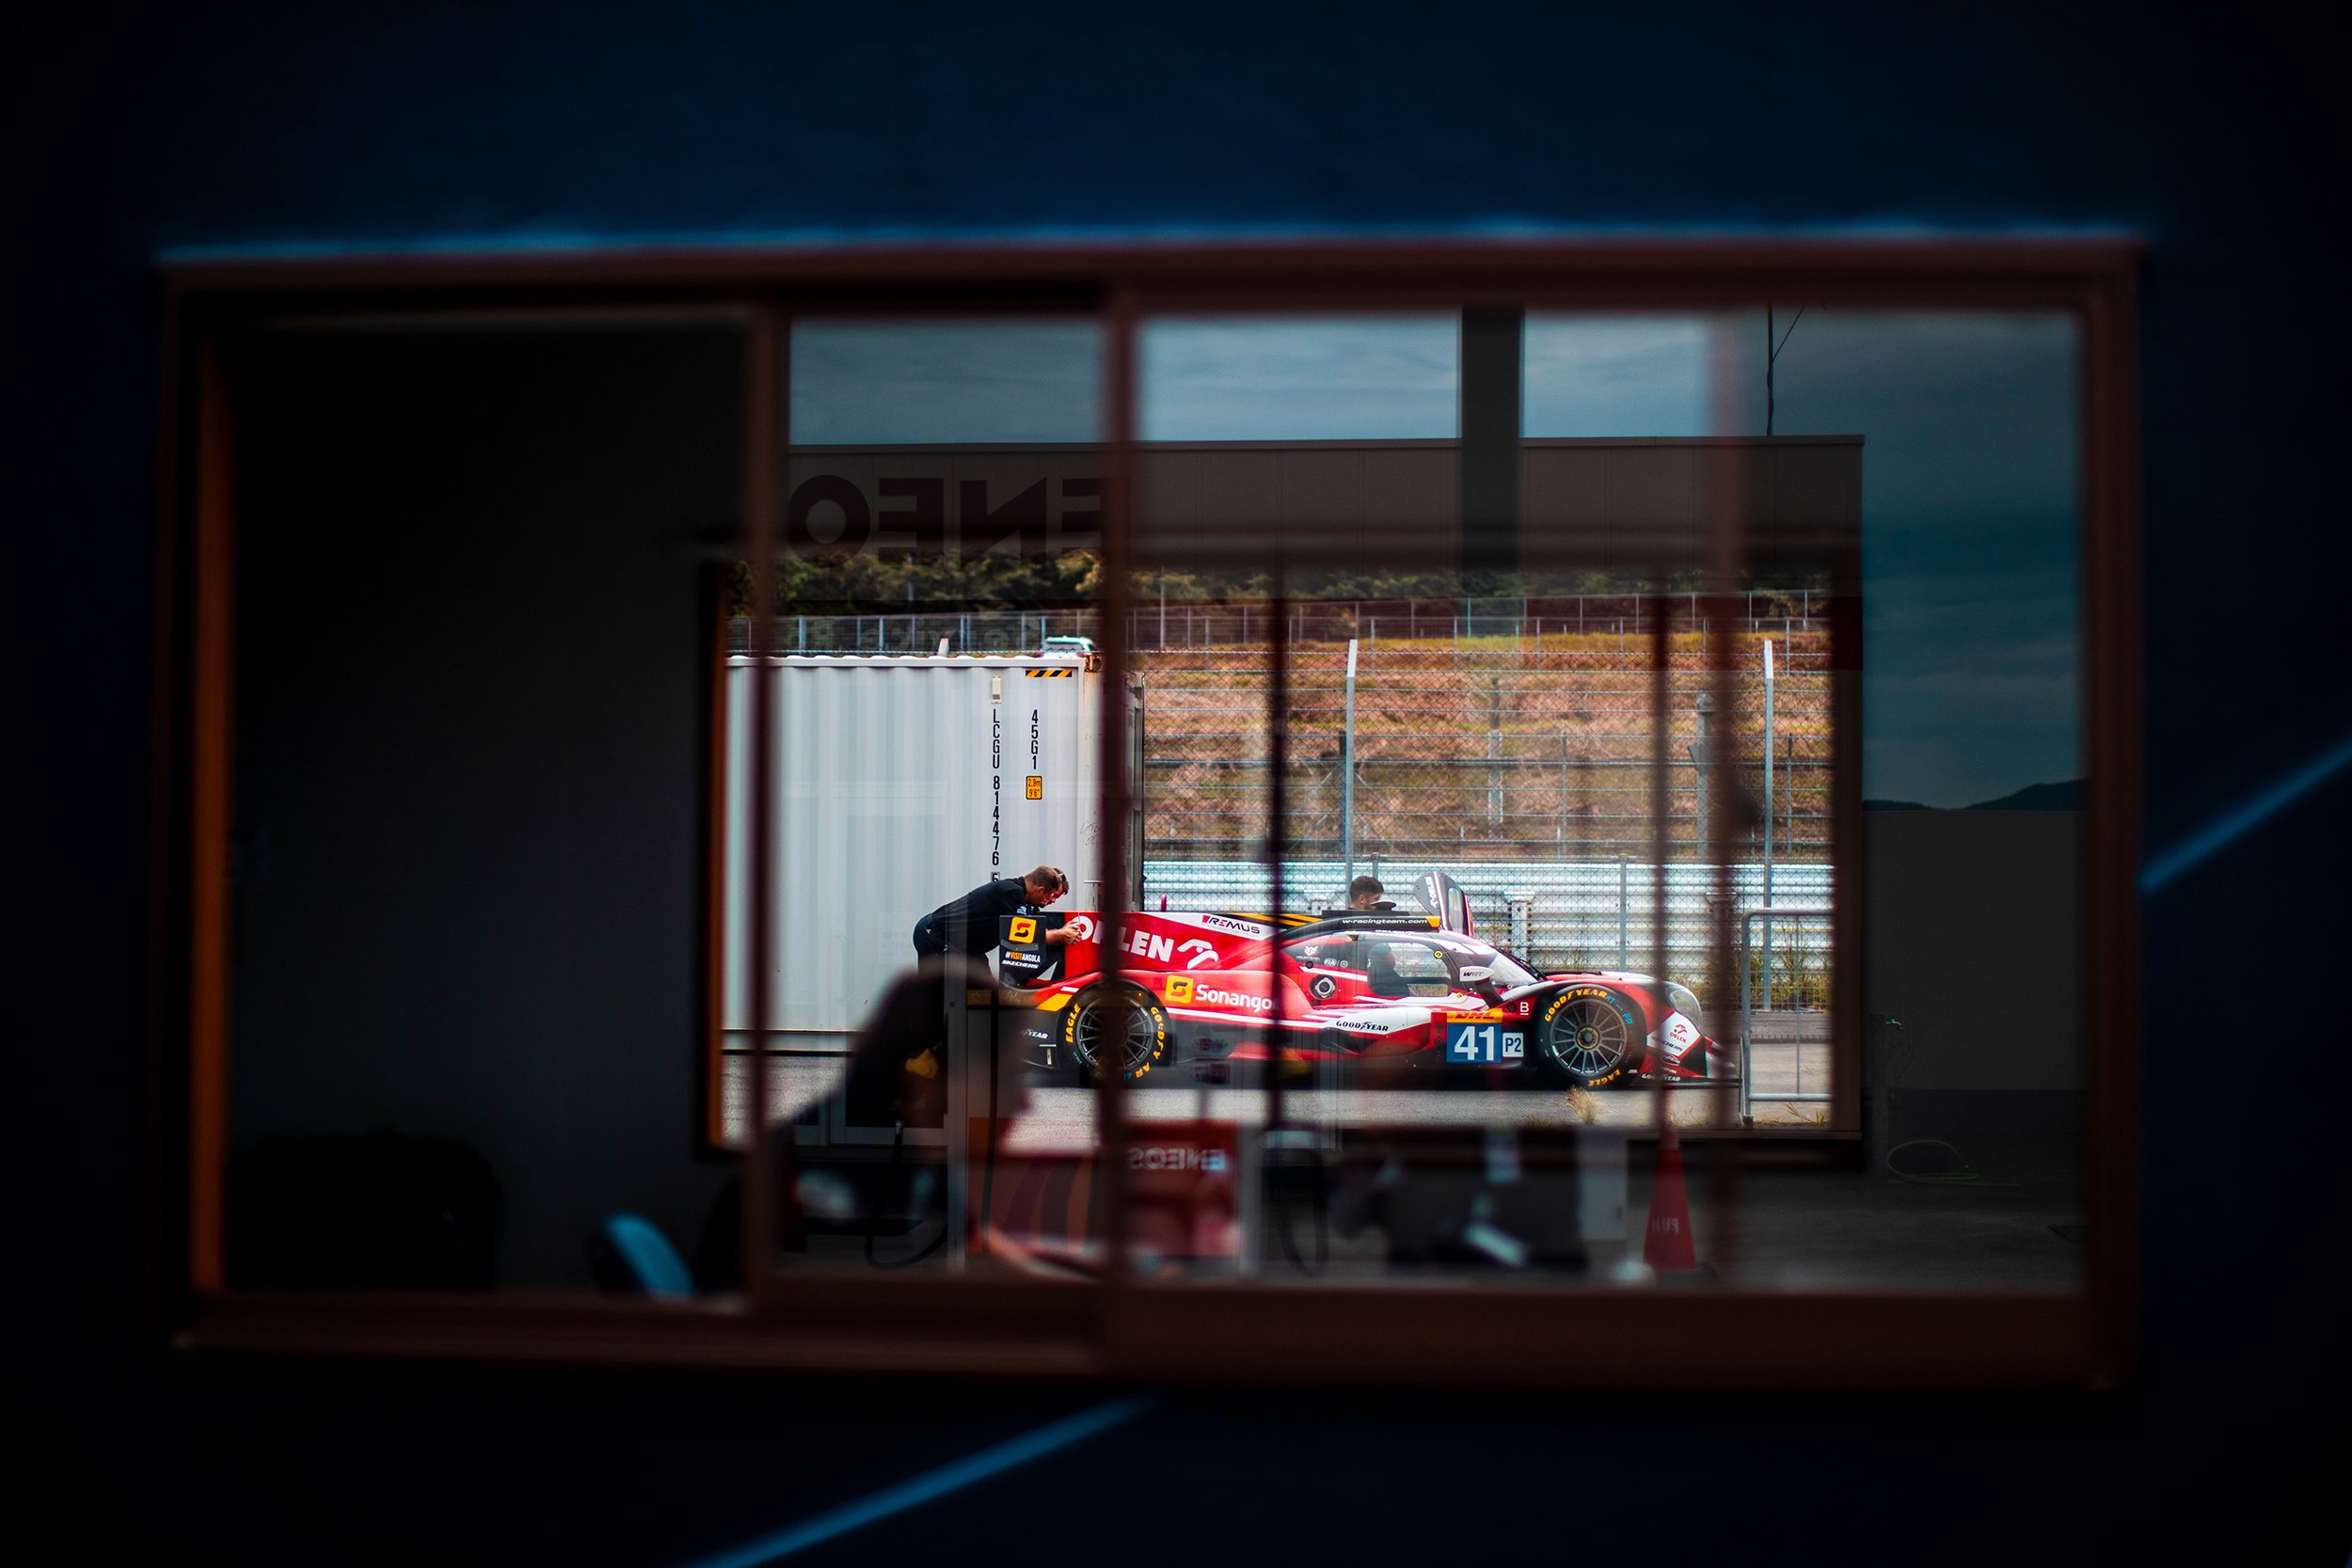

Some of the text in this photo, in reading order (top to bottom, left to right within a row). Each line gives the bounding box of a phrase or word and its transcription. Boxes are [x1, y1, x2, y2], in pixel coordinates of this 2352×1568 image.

[992, 775, 1000, 865] 814476
[1208, 916, 1261, 934] REMUS
[1070, 915, 1174, 962] OLEN
[1545, 989, 1608, 1022] GOODYEAR
[1065, 1003, 1082, 1043] EAGLE
[1336, 1021, 1389, 1032] GOODYEAR
[1027, 1029, 1049, 1039] YEAR
[1135, 1006, 1166, 1078] GOODYAR
[1454, 1025, 1495, 1061] 41
[1505, 1037, 1521, 1053] P2
[1661, 1040, 1683, 1052] CHERS
[1587, 1069, 1621, 1087] EAGLE
[1641, 1073, 1681, 1082] GOYEAR
